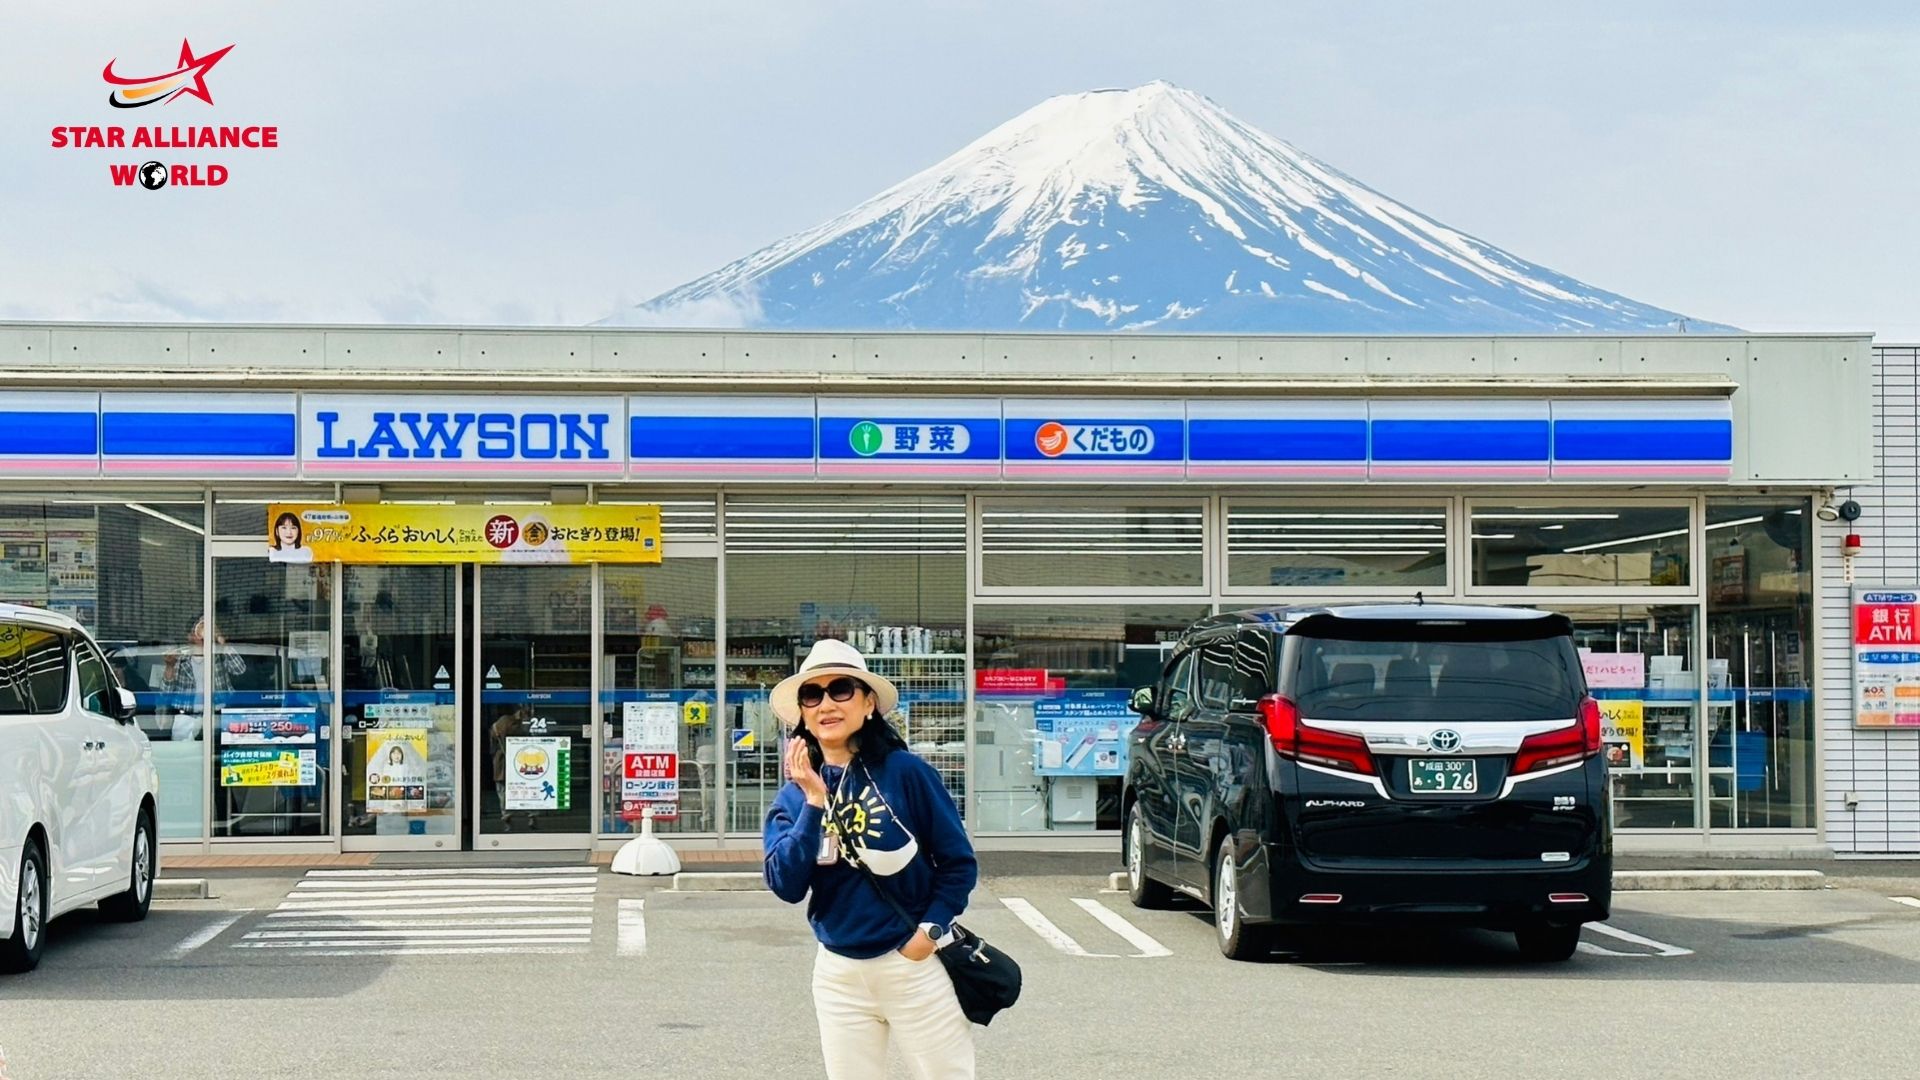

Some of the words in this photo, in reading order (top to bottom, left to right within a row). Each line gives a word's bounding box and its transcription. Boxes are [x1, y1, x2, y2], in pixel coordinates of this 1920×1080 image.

[317, 412, 609, 458] LAWSON
[894, 426, 955, 451] 野菜
[1073, 428, 1148, 451] くだもの
[489, 519, 514, 544] 新
[1866, 593, 1914, 601] ATMサービス
[1872, 608, 1910, 624] 銀行
[1869, 626, 1912, 641] ATM
[530, 717, 547, 728] 24
[631, 756, 670, 769] ATM
[1445, 762, 1462, 771] 300
[626, 781, 675, 790] ローソン銀行
[1305, 799, 1365, 807] ALPHARD
